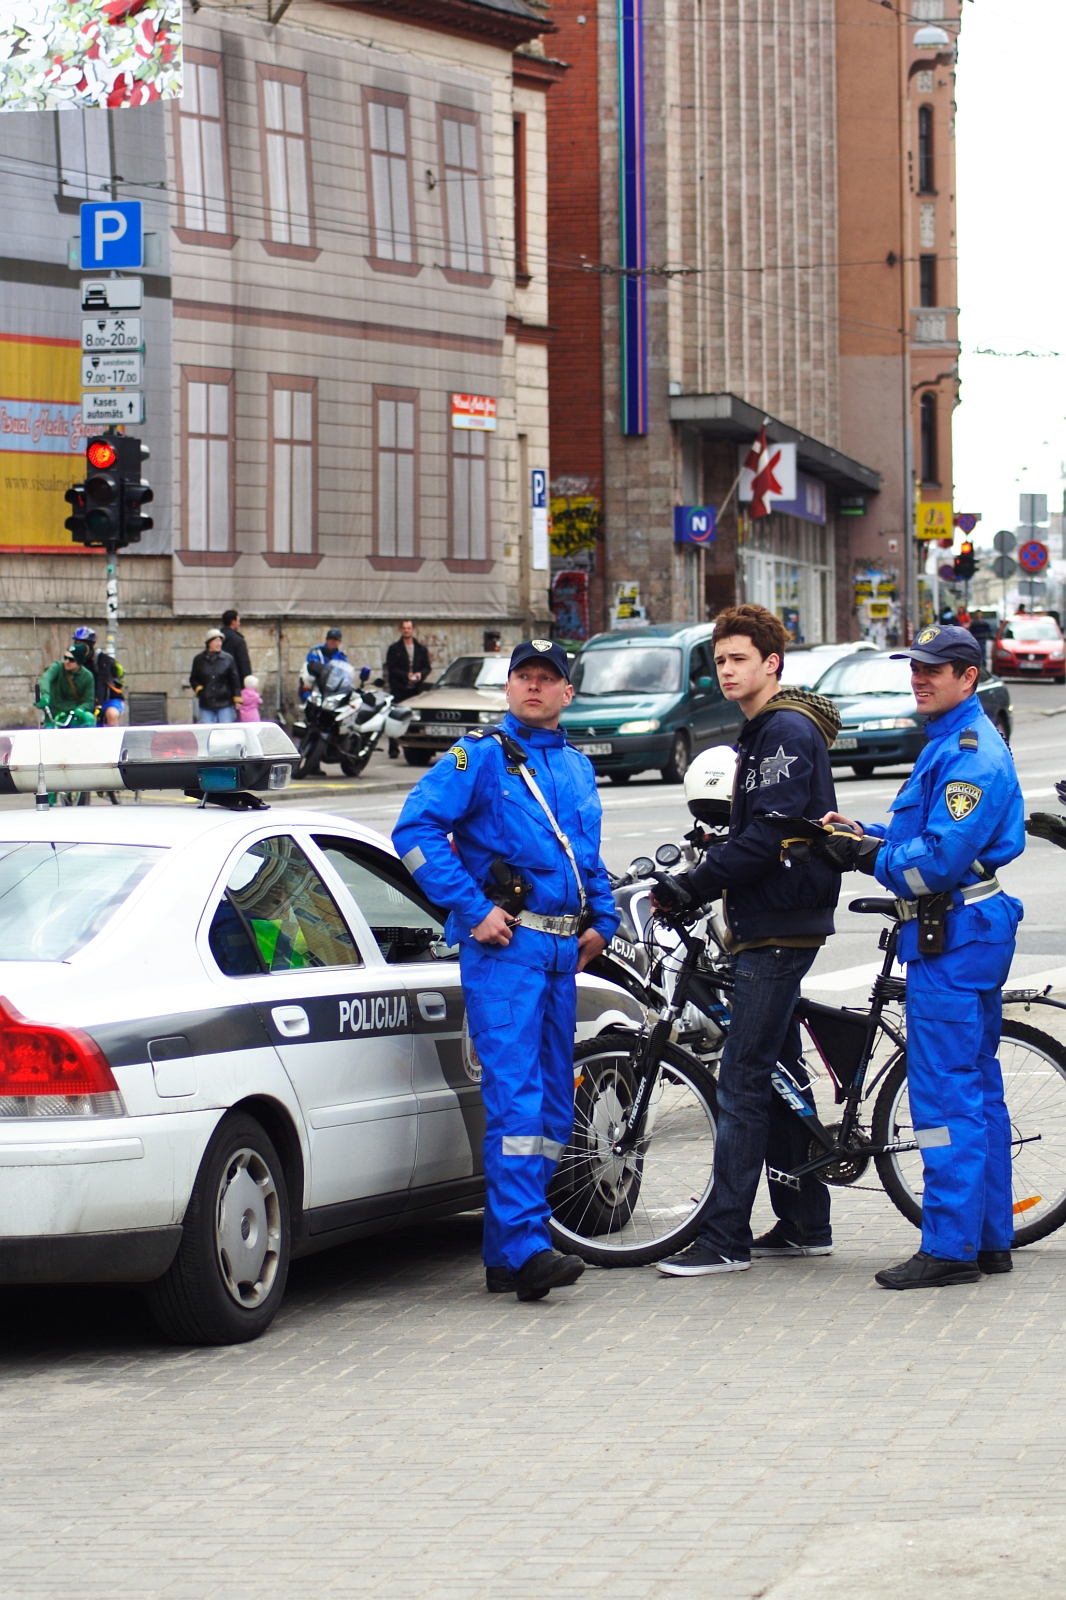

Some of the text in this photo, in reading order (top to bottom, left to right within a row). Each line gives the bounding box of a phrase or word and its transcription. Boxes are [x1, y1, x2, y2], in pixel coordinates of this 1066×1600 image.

[95, 209, 128, 261] P
[85, 333, 138, 347] 8.00-20.00
[102, 358, 135, 367] sestdienās
[86, 370, 137, 383] 9.00-17.00
[93, 397, 117, 407] Kases
[86, 407, 124, 420] automāts
[534, 472, 544, 506] P
[692, 516, 707, 532] N
[948, 785, 979, 798] POLICIJA
[608, 936, 636, 962] ICIJA
[338, 995, 408, 1033] POLICIJA
[627, 1076, 647, 1129] MERIDA
